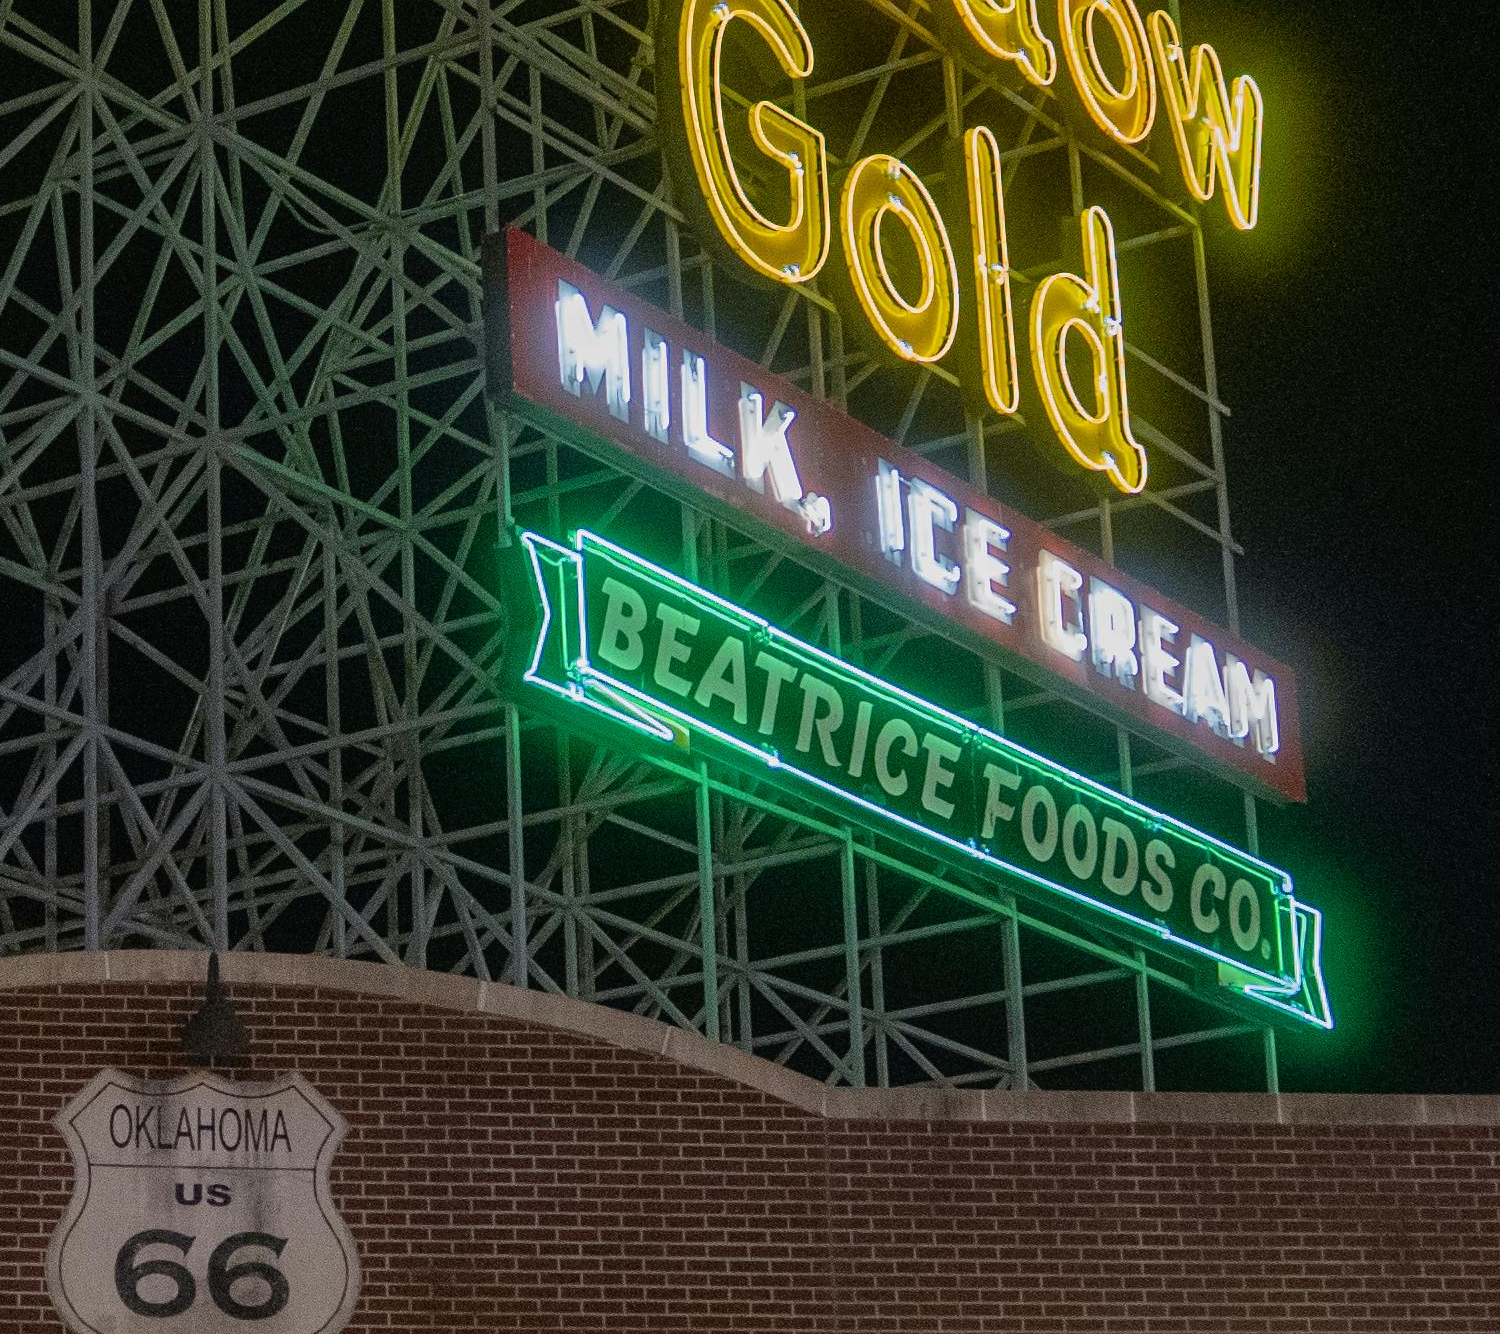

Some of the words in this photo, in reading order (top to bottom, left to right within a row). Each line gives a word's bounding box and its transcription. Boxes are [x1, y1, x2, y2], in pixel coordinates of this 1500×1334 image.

[555, 279, 834, 536] MILK,
[875, 456, 1017, 626] ICE
[1038, 547, 1280, 764] CREAM
[598, 577, 964, 821] BEATRICE
[981, 763, 1176, 914] FOODS
[1189, 862, 1272, 960] CO.
[109, 1103, 292, 1153] OKLAHOMA
[175, 1182, 233, 1208] US
[114, 1228, 290, 1321] 66
